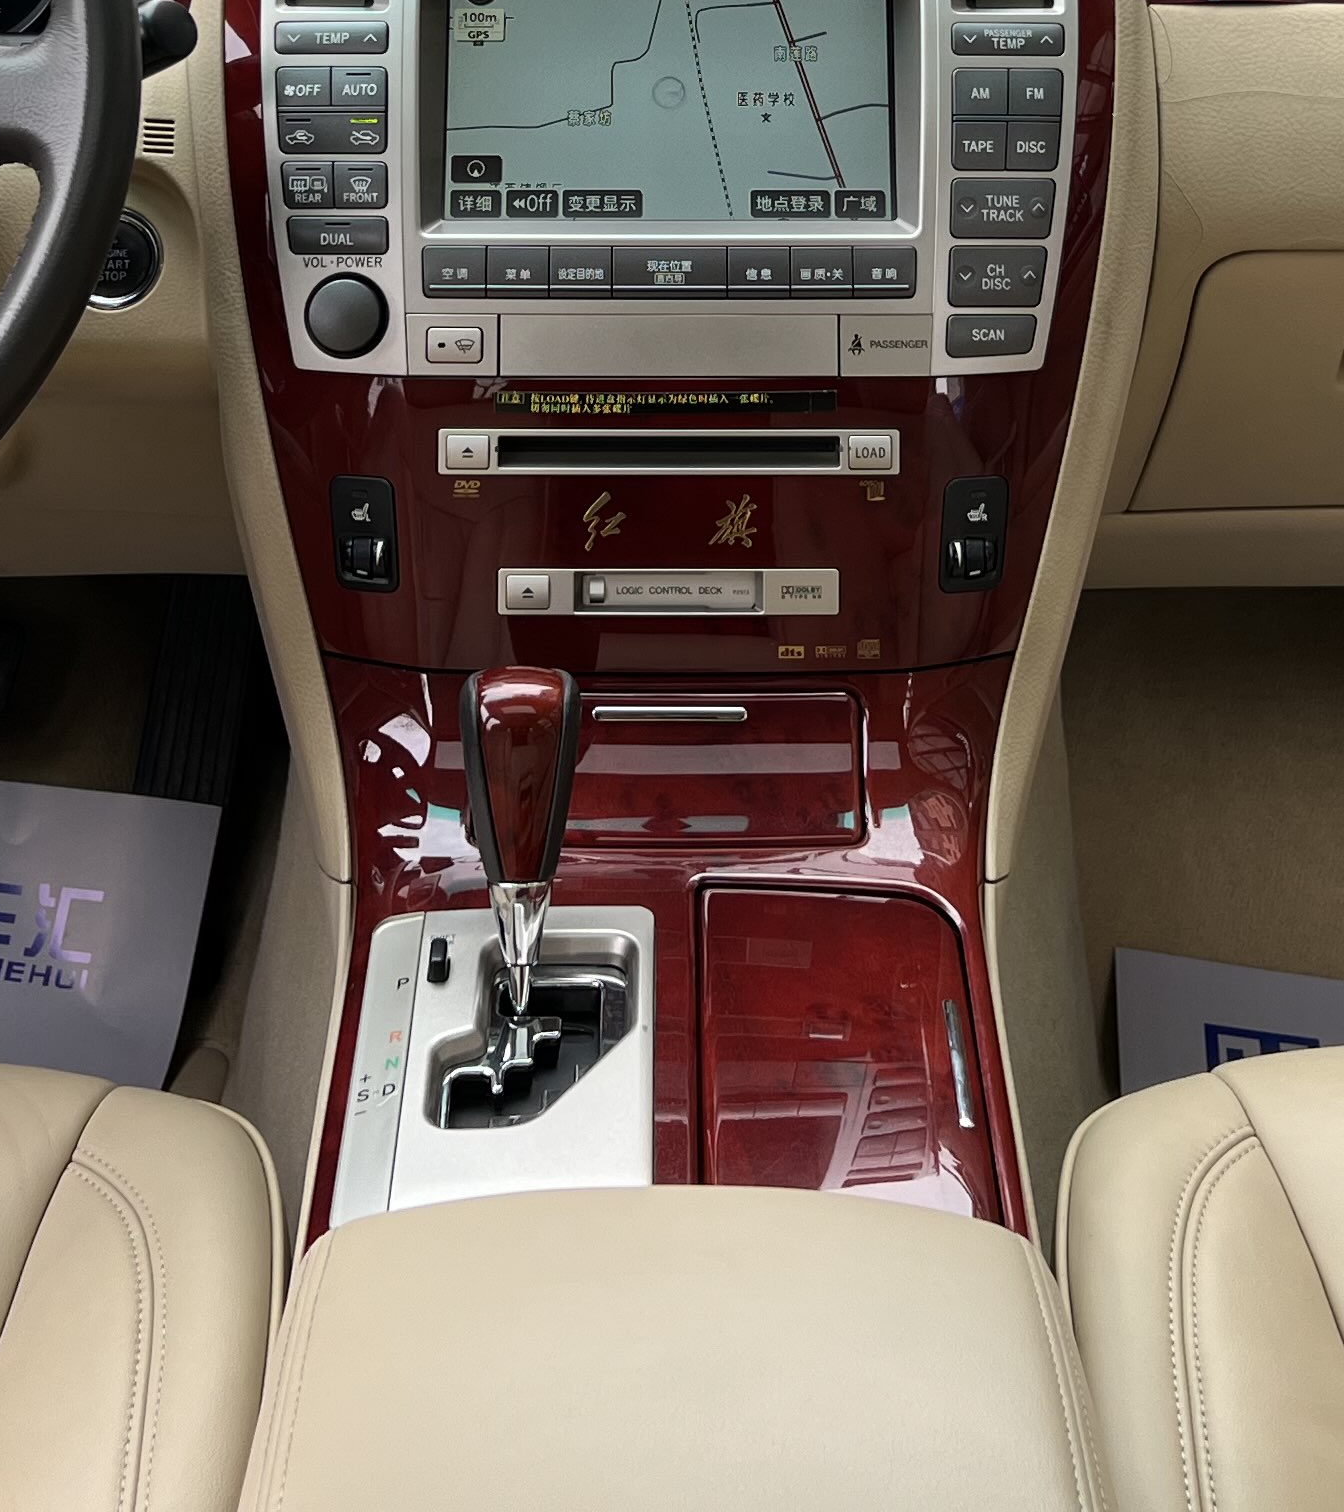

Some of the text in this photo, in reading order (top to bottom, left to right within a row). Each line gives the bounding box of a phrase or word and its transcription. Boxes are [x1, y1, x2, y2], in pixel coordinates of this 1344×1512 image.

[462, 12, 497, 24] 100m
[314, 31, 350, 45] TEMP
[468, 30, 490, 41] GPS
[984, 29, 1032, 38] PASSENGER
[991, 37, 1026, 50] TEMP
[773, 45, 819, 63] 南莲路
[295, 84, 322, 97] OFF
[342, 83, 378, 97] AUTO
[971, 88, 990, 100] AM
[1026, 88, 1044, 100] FM
[737, 91, 795, 108] 医药学校
[962, 140, 994, 154] TAPE
[1016, 140, 1046, 154] DISC
[294, 192, 322, 204] REAR
[343, 192, 379, 204] FRONT
[458, 195, 492, 212] 详细
[526, 193, 553, 212] Off
[568, 195, 637, 212] 变更显示
[756, 195, 825, 213] 地点登录
[842, 195, 878, 213] 广域
[985, 195, 1020, 207] TUNE
[981, 209, 1024, 222] TRACK
[320, 232, 354, 246] DUAL
[646, 260, 693, 273] 现在位置
[987, 264, 1005, 276] CH
[98, 271, 127, 281] STOP
[441, 268, 469, 280] 空调
[505, 268, 531, 280] 菜单
[558, 268, 604, 280] 设定目的地
[745, 268, 772, 280] 信息
[871, 268, 897, 280] 音响
[981, 277, 1011, 290] DISC
[971, 329, 1005, 342] SCAN
[870, 339, 928, 350] PASSENGER
[856, 445, 887, 461] LOAD
[583, 491, 757, 551] 红旗
[616, 586, 643, 595] LOGIC
[649, 586, 693, 595] CONTROL
[699, 586, 722, 595] DECK
[795, 586, 821, 594] DOLBY
[397, 977, 409, 989] P
[389, 1030, 402, 1042] R
[384, 1056, 399, 1070] N
[357, 1083, 395, 1103] S D
